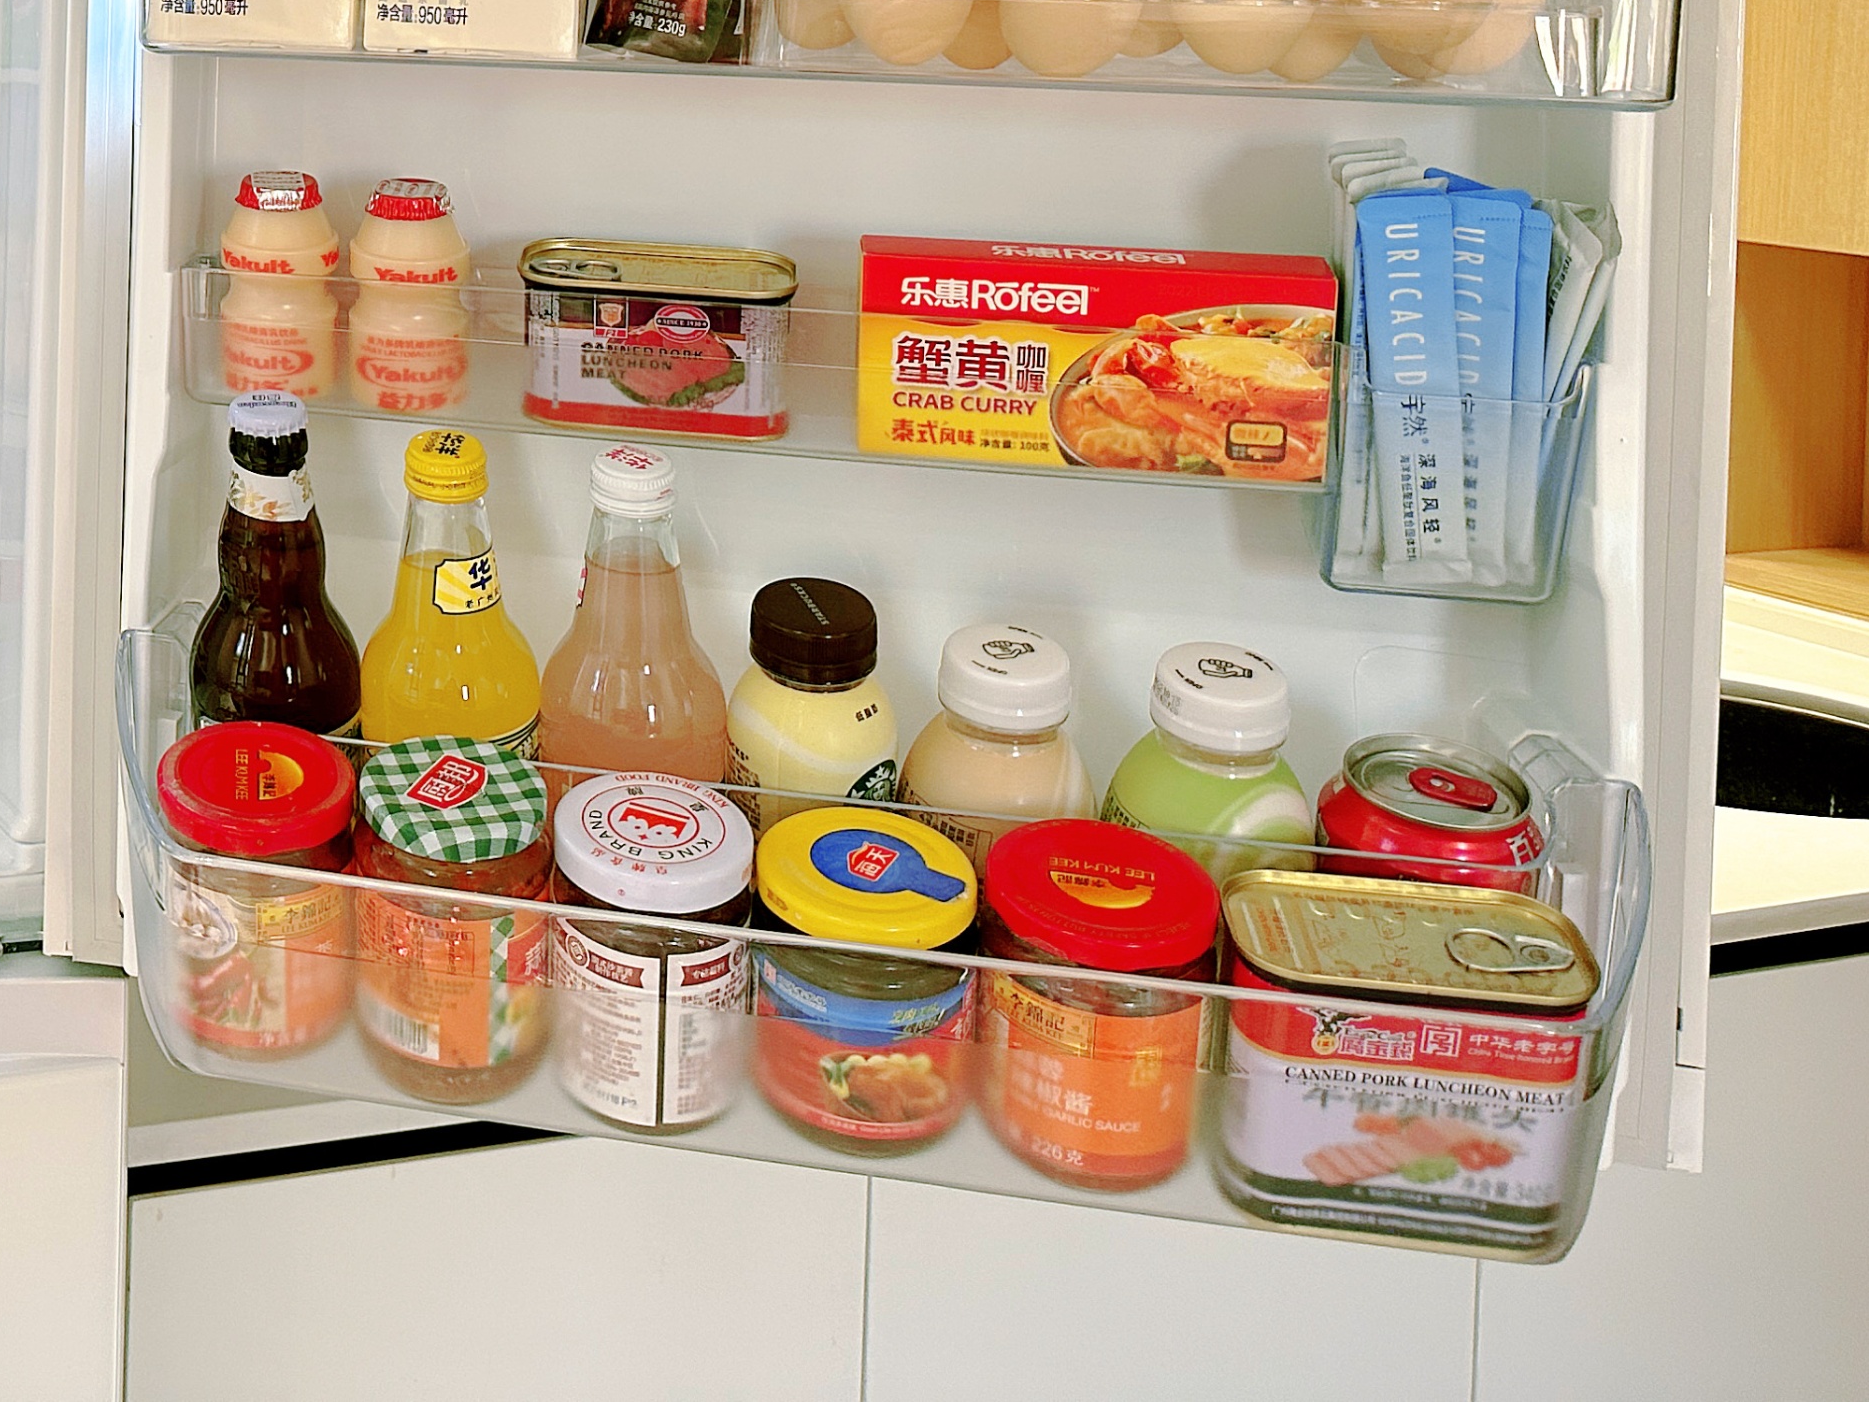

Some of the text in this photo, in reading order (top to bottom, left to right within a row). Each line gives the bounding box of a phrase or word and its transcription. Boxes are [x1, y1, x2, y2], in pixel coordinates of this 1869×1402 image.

[377, 4, 469, 26] 净含量:950毫升
[223, 248, 295, 274] Yakult
[374, 266, 458, 285] Yakult
[901, 276, 969, 309] 乐惠
[371, 361, 461, 384] Yakult
[581, 355, 673, 371] LUNCHEON
[581, 368, 627, 379] MEAT
[895, 334, 1048, 394] 蟹黄 咖喱
[892, 391, 1038, 416] CRAB CURRY
[891, 418, 975, 446] 泰式风味
[1417, 454, 1440, 533] 深海风轻
[235, 749, 248, 800] LEE KUM KEE
[589, 809, 713, 860] KING BRAND
[855, 847, 893, 879] 海天
[1049, 856, 1155, 881] LEE KUM KEE
[1469, 1033, 1575, 1055] 中华老字号
[1285, 1065, 1566, 1108] CANNED PORK LUNCHEON MEAT
[1095, 1117, 1142, 1133] SAUCE
